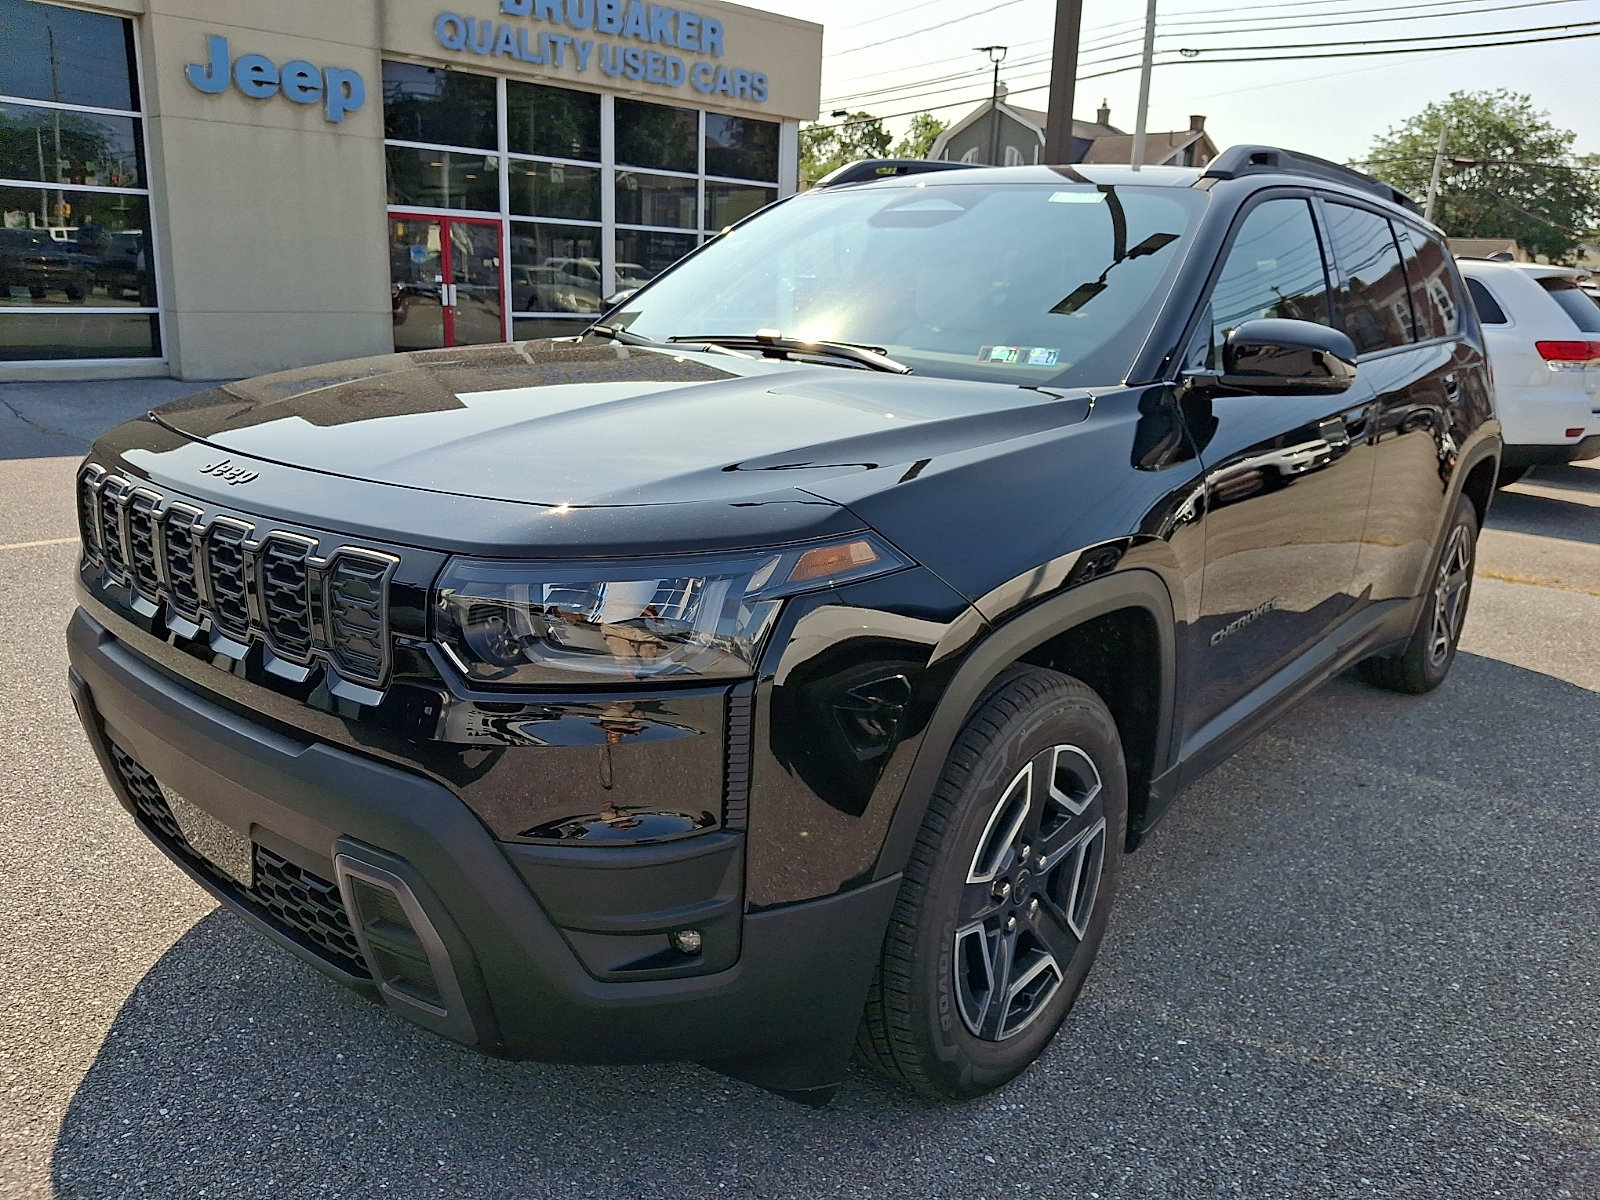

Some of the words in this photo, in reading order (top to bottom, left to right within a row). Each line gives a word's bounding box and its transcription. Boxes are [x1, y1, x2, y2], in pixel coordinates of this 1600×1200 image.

[185, 35, 366, 122] Jeep
[434, 12, 594, 71] QUALITY
[600, 43, 686, 87] USED
[691, 62, 769, 103] CARS
[199, 458, 260, 486] Jeep
[1209, 595, 1279, 648] CHEROKEE
